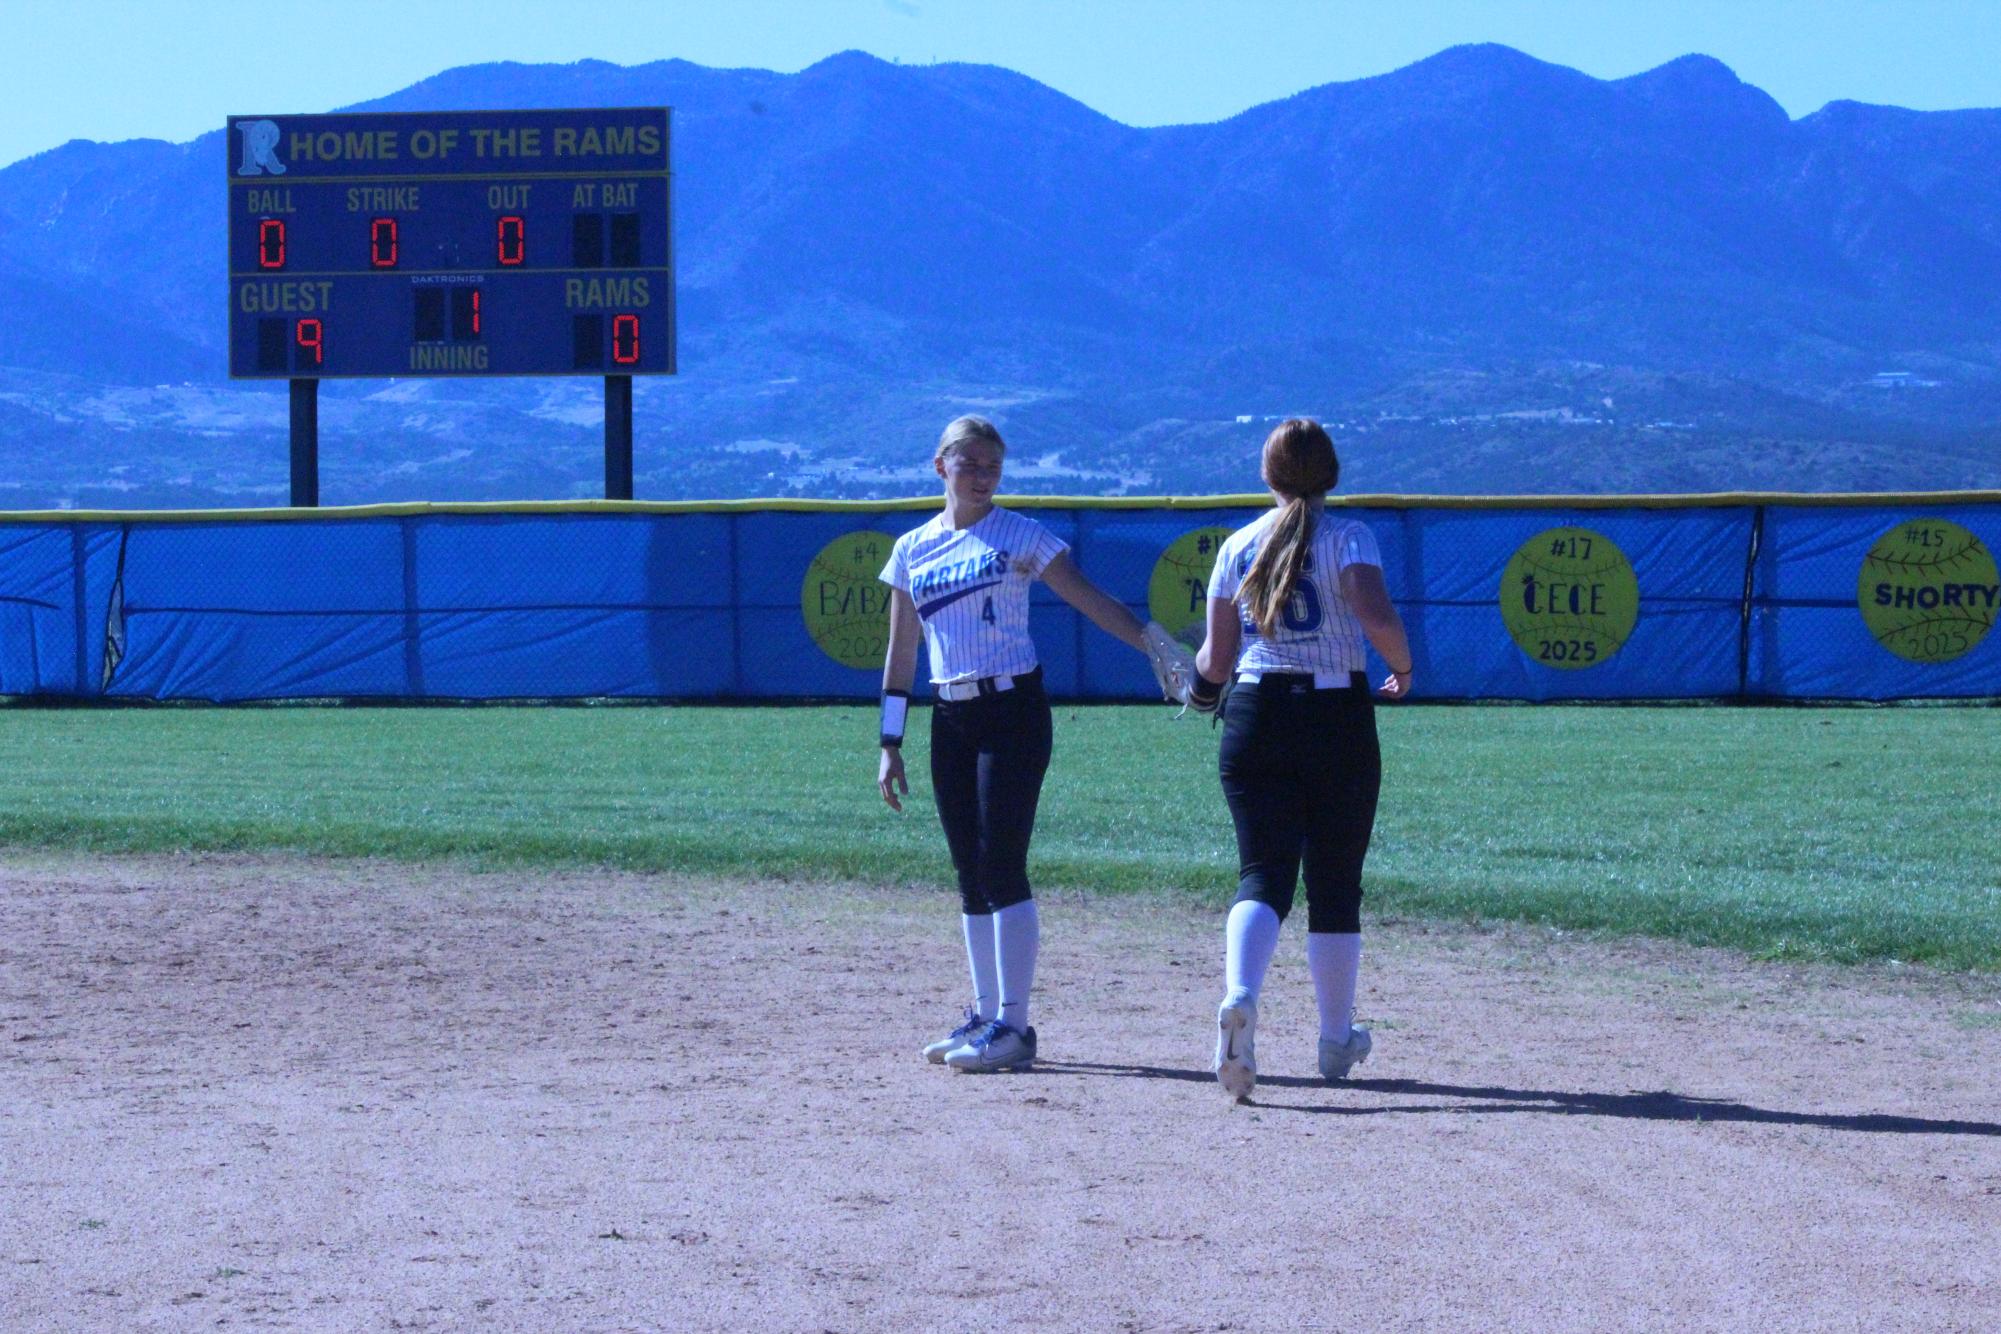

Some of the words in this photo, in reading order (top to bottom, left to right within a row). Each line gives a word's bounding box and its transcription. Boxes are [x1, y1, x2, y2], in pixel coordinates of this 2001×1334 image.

[290, 131, 398, 160] HOME
[410, 129, 459, 159] OF
[470, 128, 541, 157] THE
[554, 126, 661, 156] RAMS
[248, 190, 296, 213] BALL
[347, 187, 419, 212] STRIKE
[487, 185, 531, 209] OUT
[573, 184, 596, 208] AT
[602, 183, 638, 208] BAT
[260, 220, 285, 267] 0
[372, 219, 397, 266] 0
[498, 216, 524, 264] 0
[411, 275, 485, 283] DAKTRONICS
[240, 282, 333, 312] GUEST
[565, 278, 649, 308] RAMS
[472, 291, 480, 333] 1
[297, 319, 322, 364] 9
[613, 315, 639, 363] 0
[409, 346, 488, 370] INNING
[1197, 534, 1227, 555] #1
[1551, 537, 1592, 560] #17
[1905, 527, 1947, 547] #15
[854, 542, 879, 563] #4
[912, 551, 1009, 601] PARTANS
[1523, 580, 1606, 615] CECE
[1875, 582, 1999, 610] SHORTY
[982, 597, 996, 625] 4
[840, 637, 890, 658] 202
[1539, 640, 1597, 661] 2025
[1908, 632, 1968, 659] 2025
